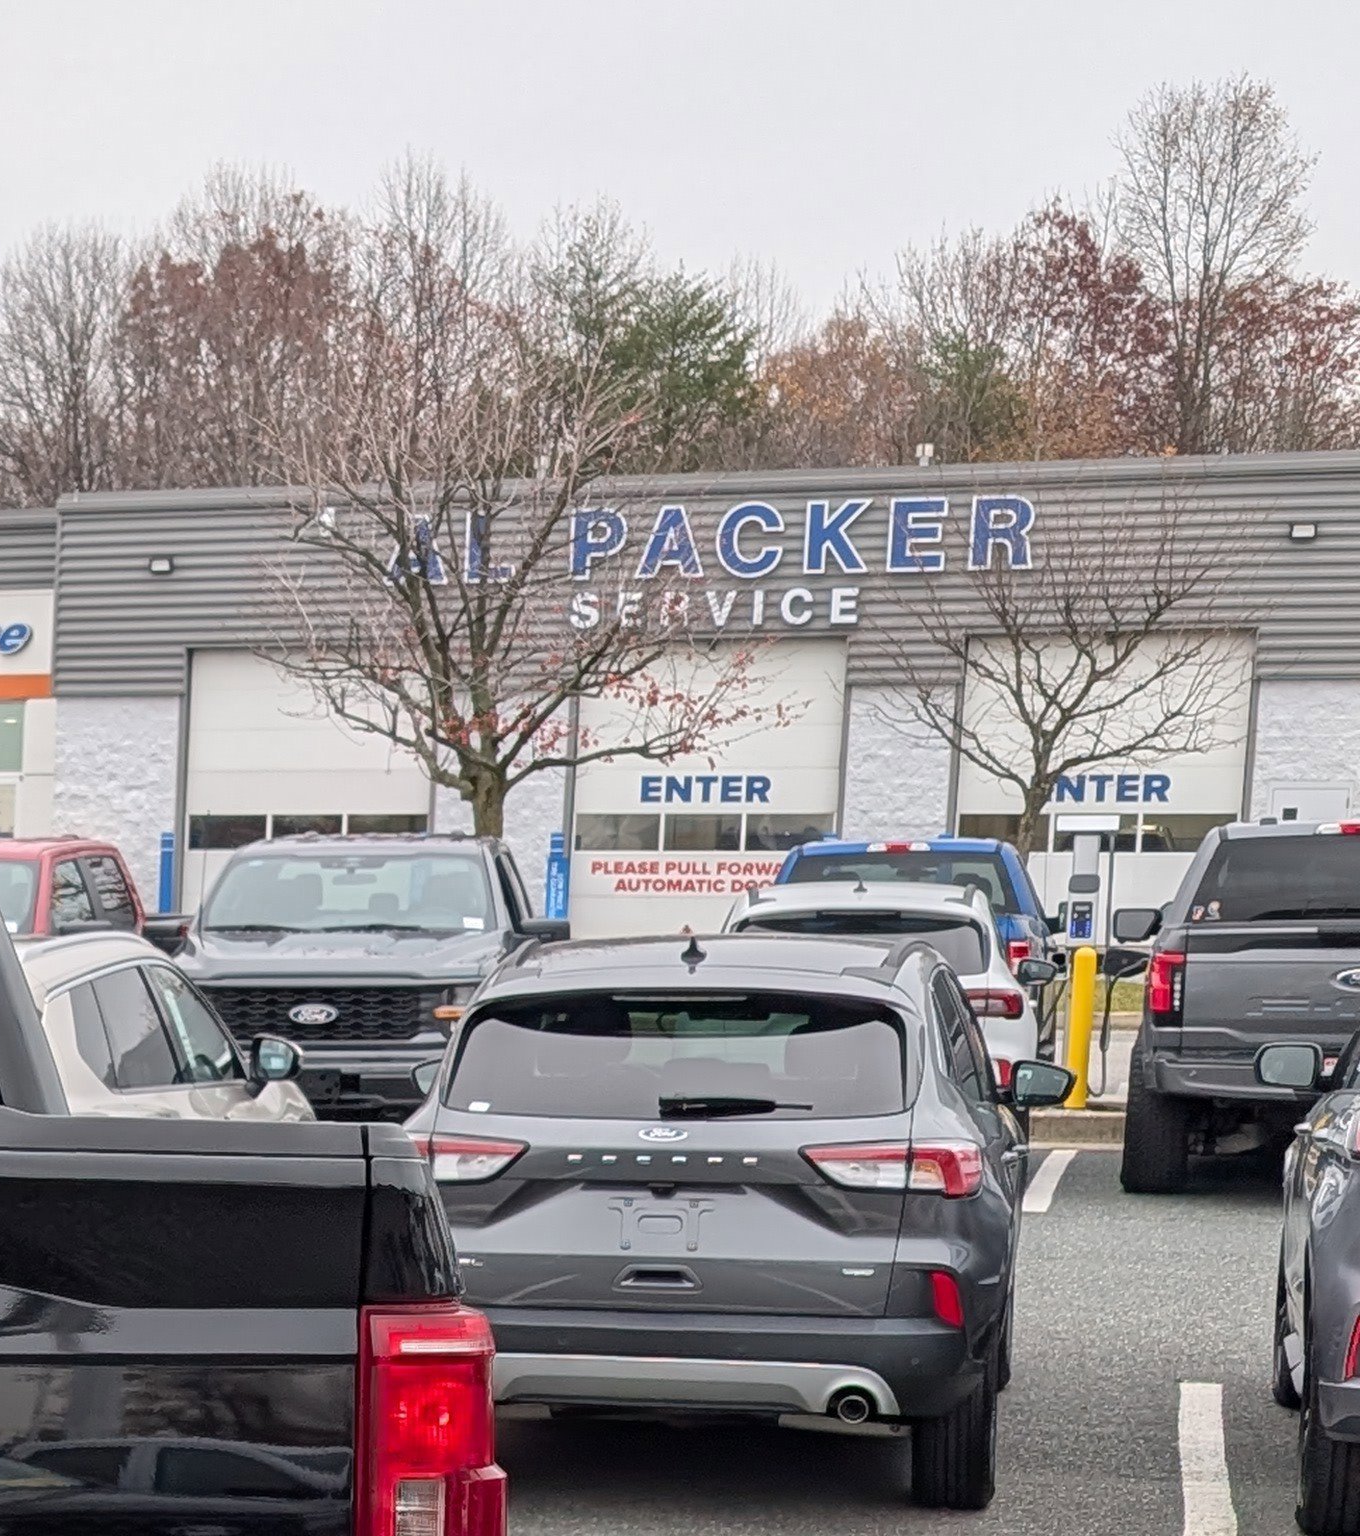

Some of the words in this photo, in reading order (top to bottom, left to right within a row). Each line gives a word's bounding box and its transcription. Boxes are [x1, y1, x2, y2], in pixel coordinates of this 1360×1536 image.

[383, 511, 516, 586] AL
[569, 495, 1036, 581] PACKER
[569, 587, 861, 630] SERVICE
[640, 775, 772, 803] ENTER
[1048, 774, 1171, 803] NTER
[590, 861, 660, 875] PLEASE
[664, 861, 711, 875] PULL
[614, 879, 726, 892] AUTOMATIC
